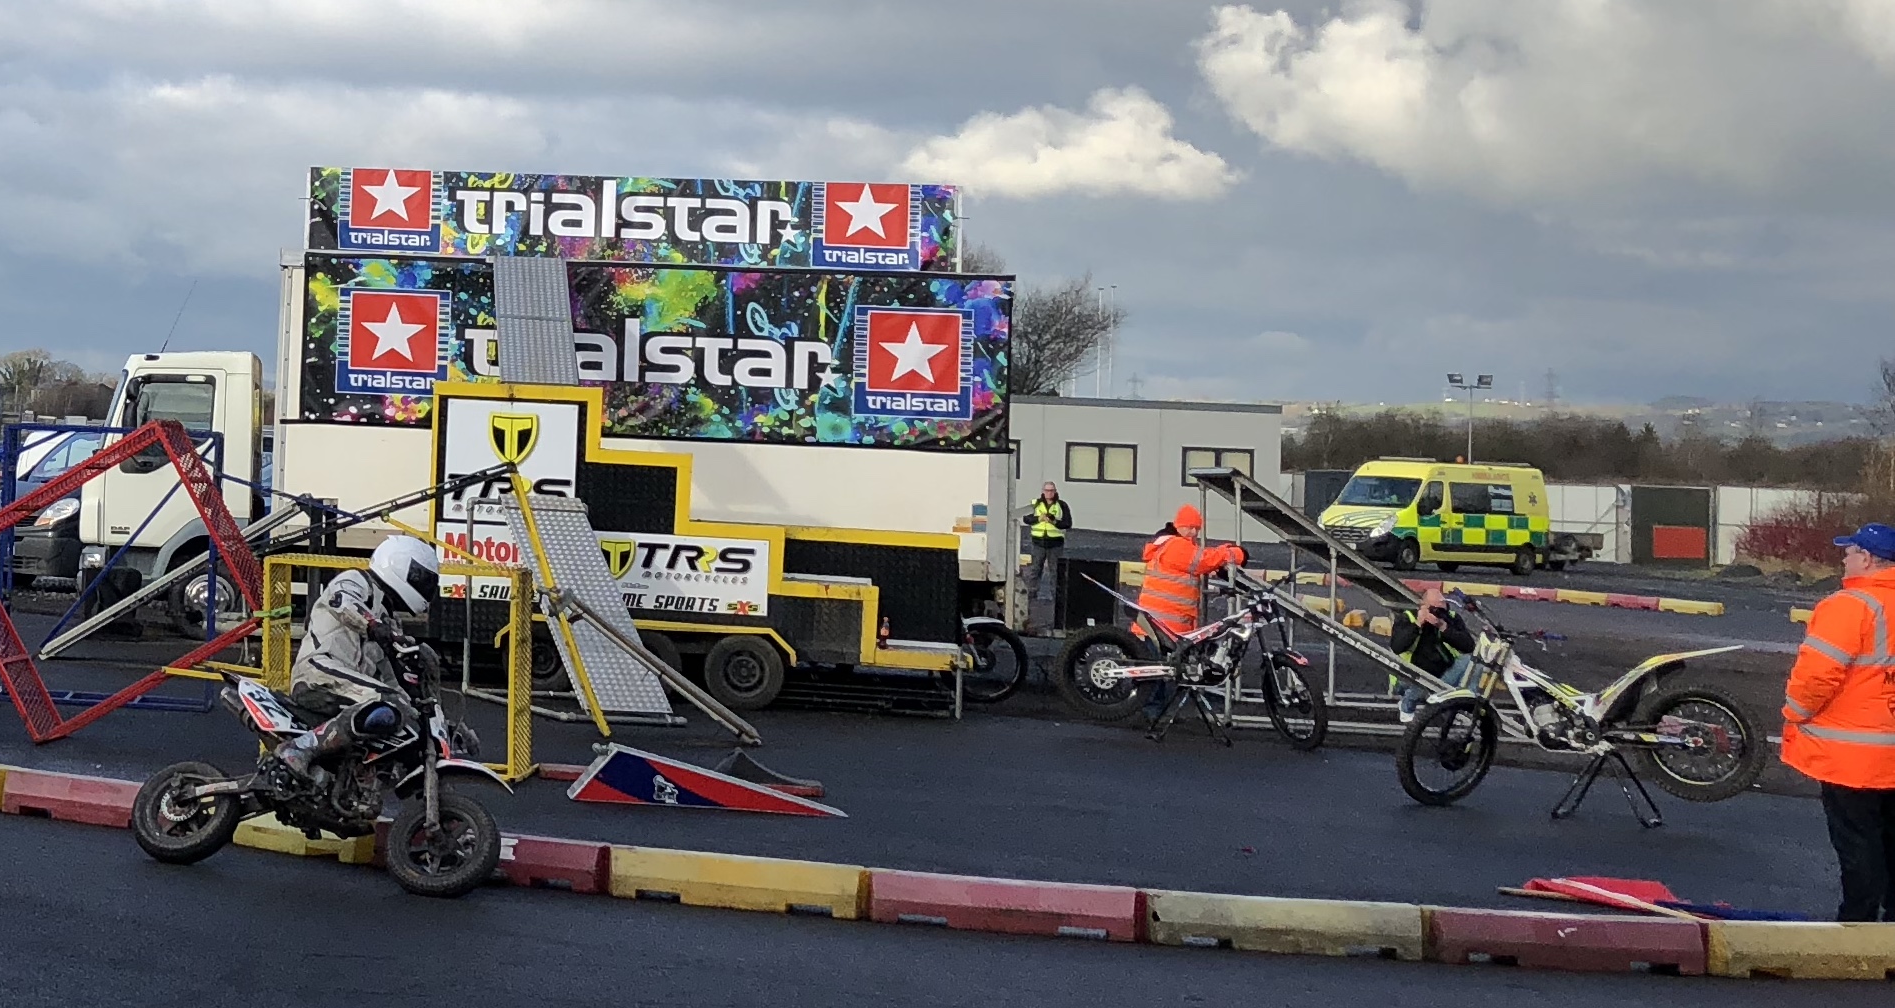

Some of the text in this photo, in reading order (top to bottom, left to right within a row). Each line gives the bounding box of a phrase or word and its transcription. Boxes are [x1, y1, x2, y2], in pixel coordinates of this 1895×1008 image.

[456, 180, 793, 245] trialstar
[349, 230, 431, 247] trialstar
[823, 248, 910, 265] trialstar
[465, 318, 832, 389] talstar
[349, 371, 435, 390] trialstar
[866, 393, 960, 413] trialstar
[653, 594, 720, 612] SPORTS
